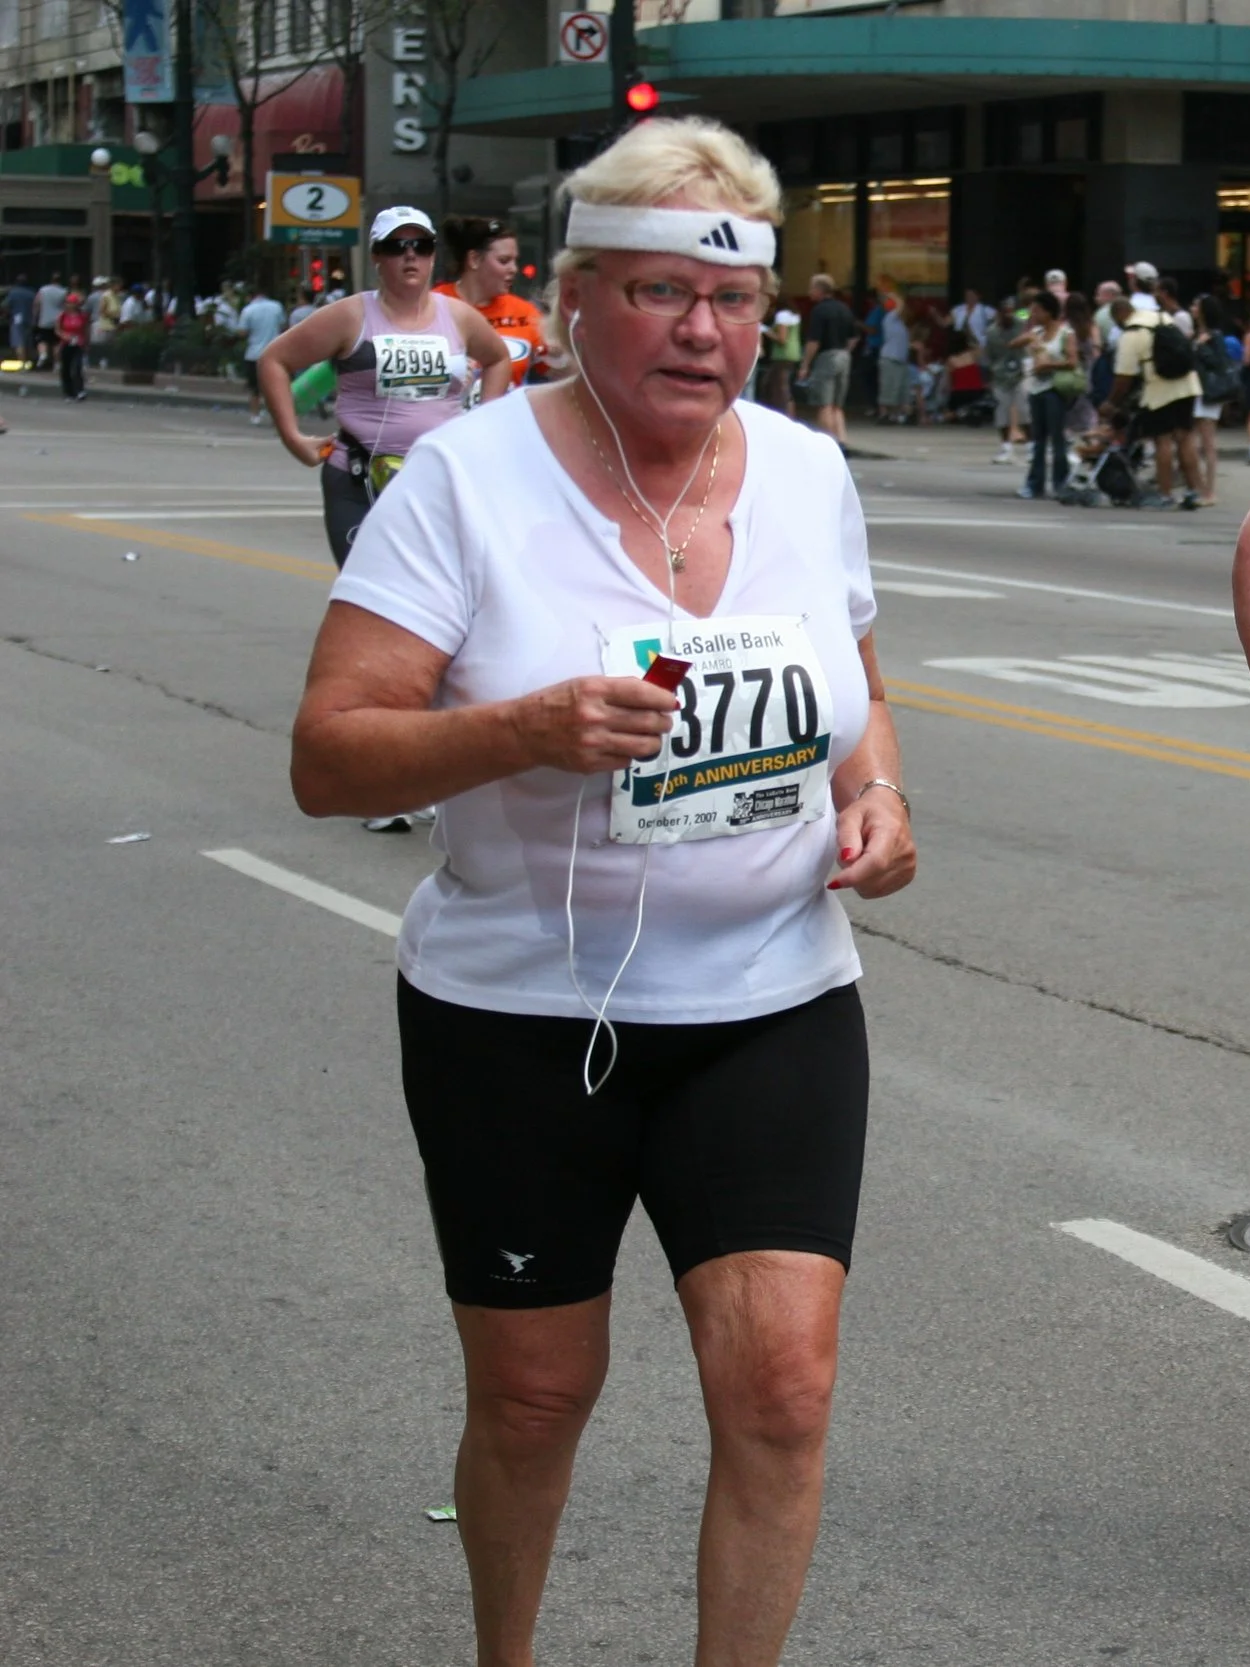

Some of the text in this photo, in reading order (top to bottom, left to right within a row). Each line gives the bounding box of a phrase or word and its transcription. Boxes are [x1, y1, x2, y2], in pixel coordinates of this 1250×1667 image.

[391, 2, 427, 152] ERS
[307, 187, 324, 210] 2
[381, 349, 447, 376] 26994
[740, 631, 784, 650] Bank
[632, 664, 818, 764] 3770
[694, 746, 818, 787] ANNIVERSARY
[695, 812, 717, 824] 2007
